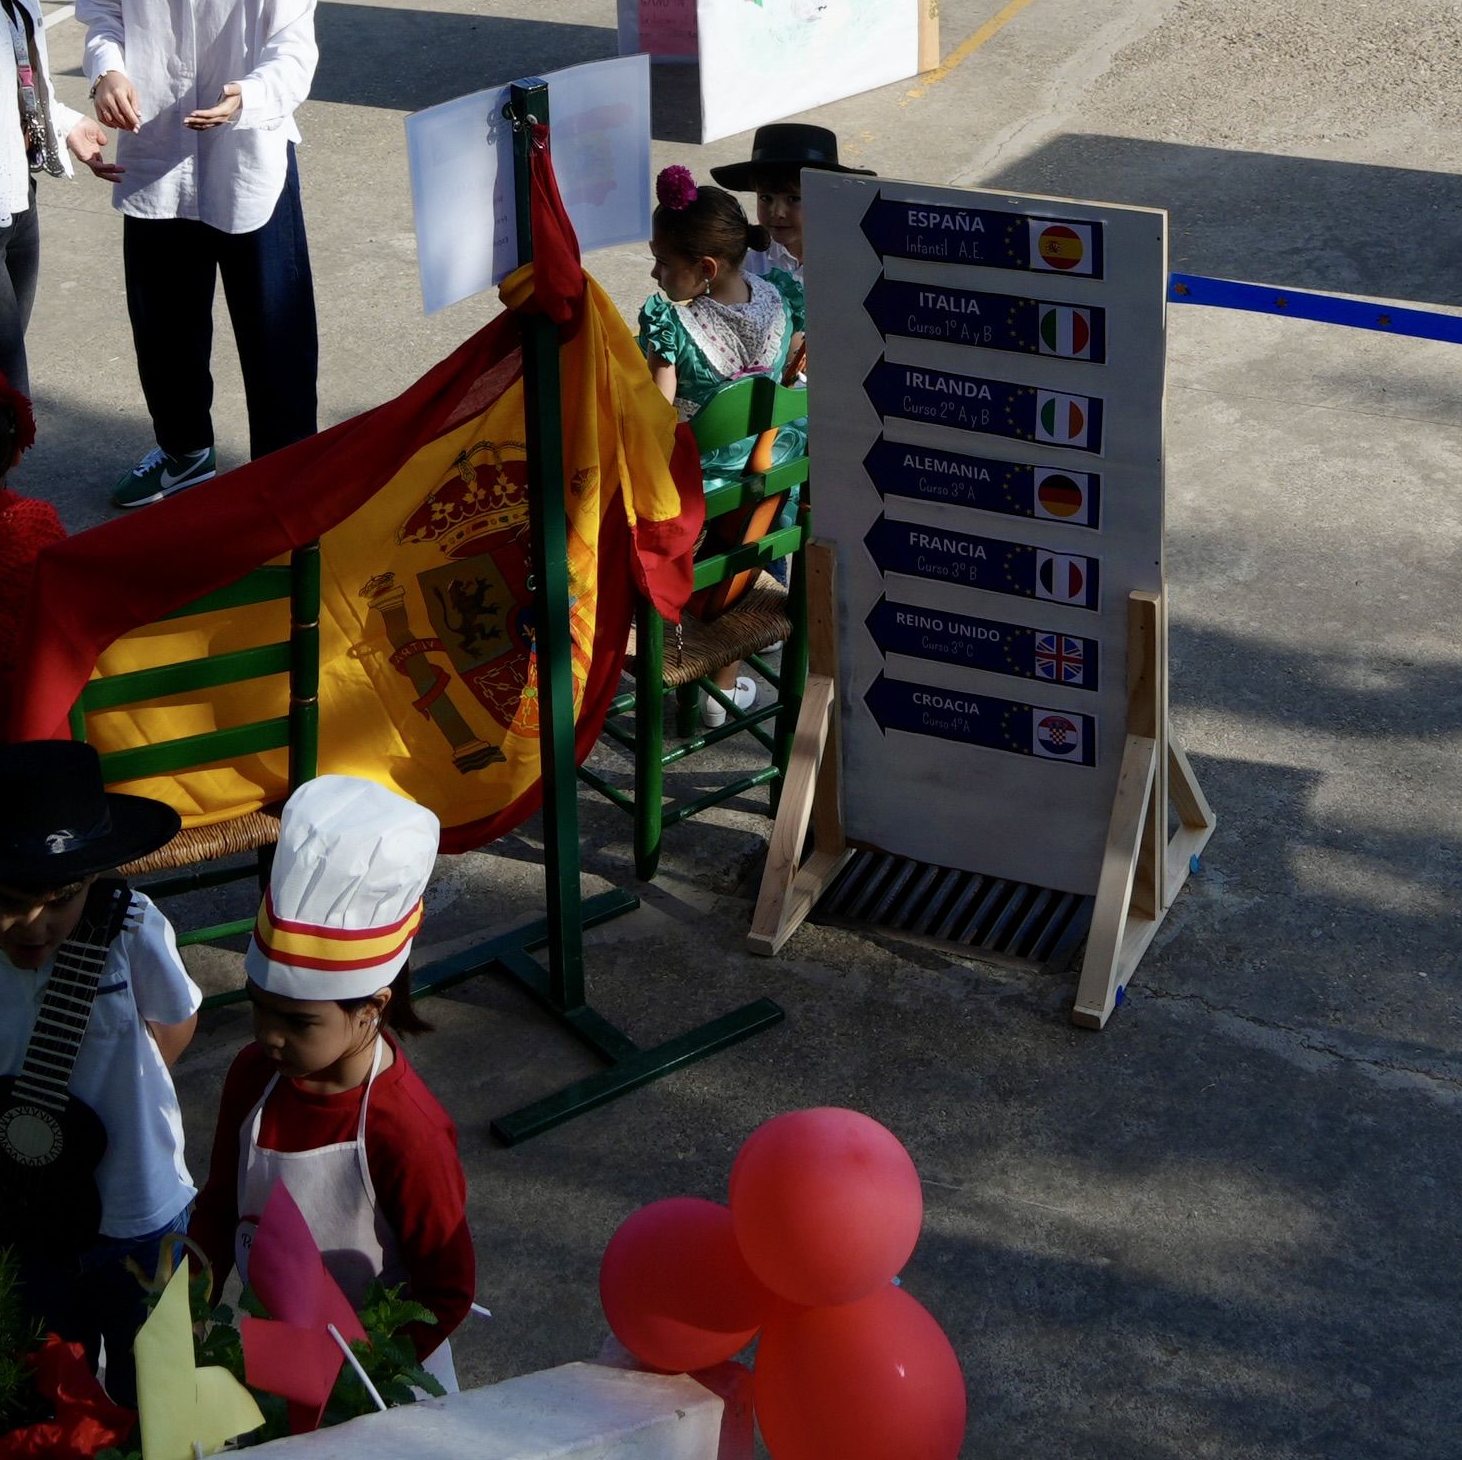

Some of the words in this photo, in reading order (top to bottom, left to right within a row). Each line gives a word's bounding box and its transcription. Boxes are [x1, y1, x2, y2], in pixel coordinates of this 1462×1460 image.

[908, 210, 985, 232] ESPAÑA
[906, 235, 948, 256] Infantil
[959, 241, 984, 259] A.E.
[919, 291, 980, 315] ITALIA
[908, 314, 941, 335] Curso
[945, 320, 957, 336] 1º
[961, 323, 969, 340] A
[973, 332, 979, 345] y
[984, 325, 992, 342] B
[906, 371, 992, 400] IRLANDA
[903, 395, 937, 416] Curso
[940, 401, 955, 418] 2º
[958, 405, 967, 422] A
[971, 414, 977, 428] y
[981, 408, 990, 425] B
[903, 454, 990, 481] ALEMANIA
[919, 476, 949, 495] Curso
[951, 482, 964, 497] 3º
[967, 485, 976, 500] A
[909, 532, 987, 560] FRANCIA
[917, 555, 949, 575] Curso
[952, 562, 966, 578] 3º
[969, 566, 977, 581] B
[896, 612, 943, 631] REINO
[948, 622, 1000, 642] UNIDO
[922, 635, 949, 652] Curso
[966, 643, 974, 658] C
[912, 692, 980, 716] CROACIA
[922, 712, 949, 730] Curso
[963, 721, 971, 733] A
